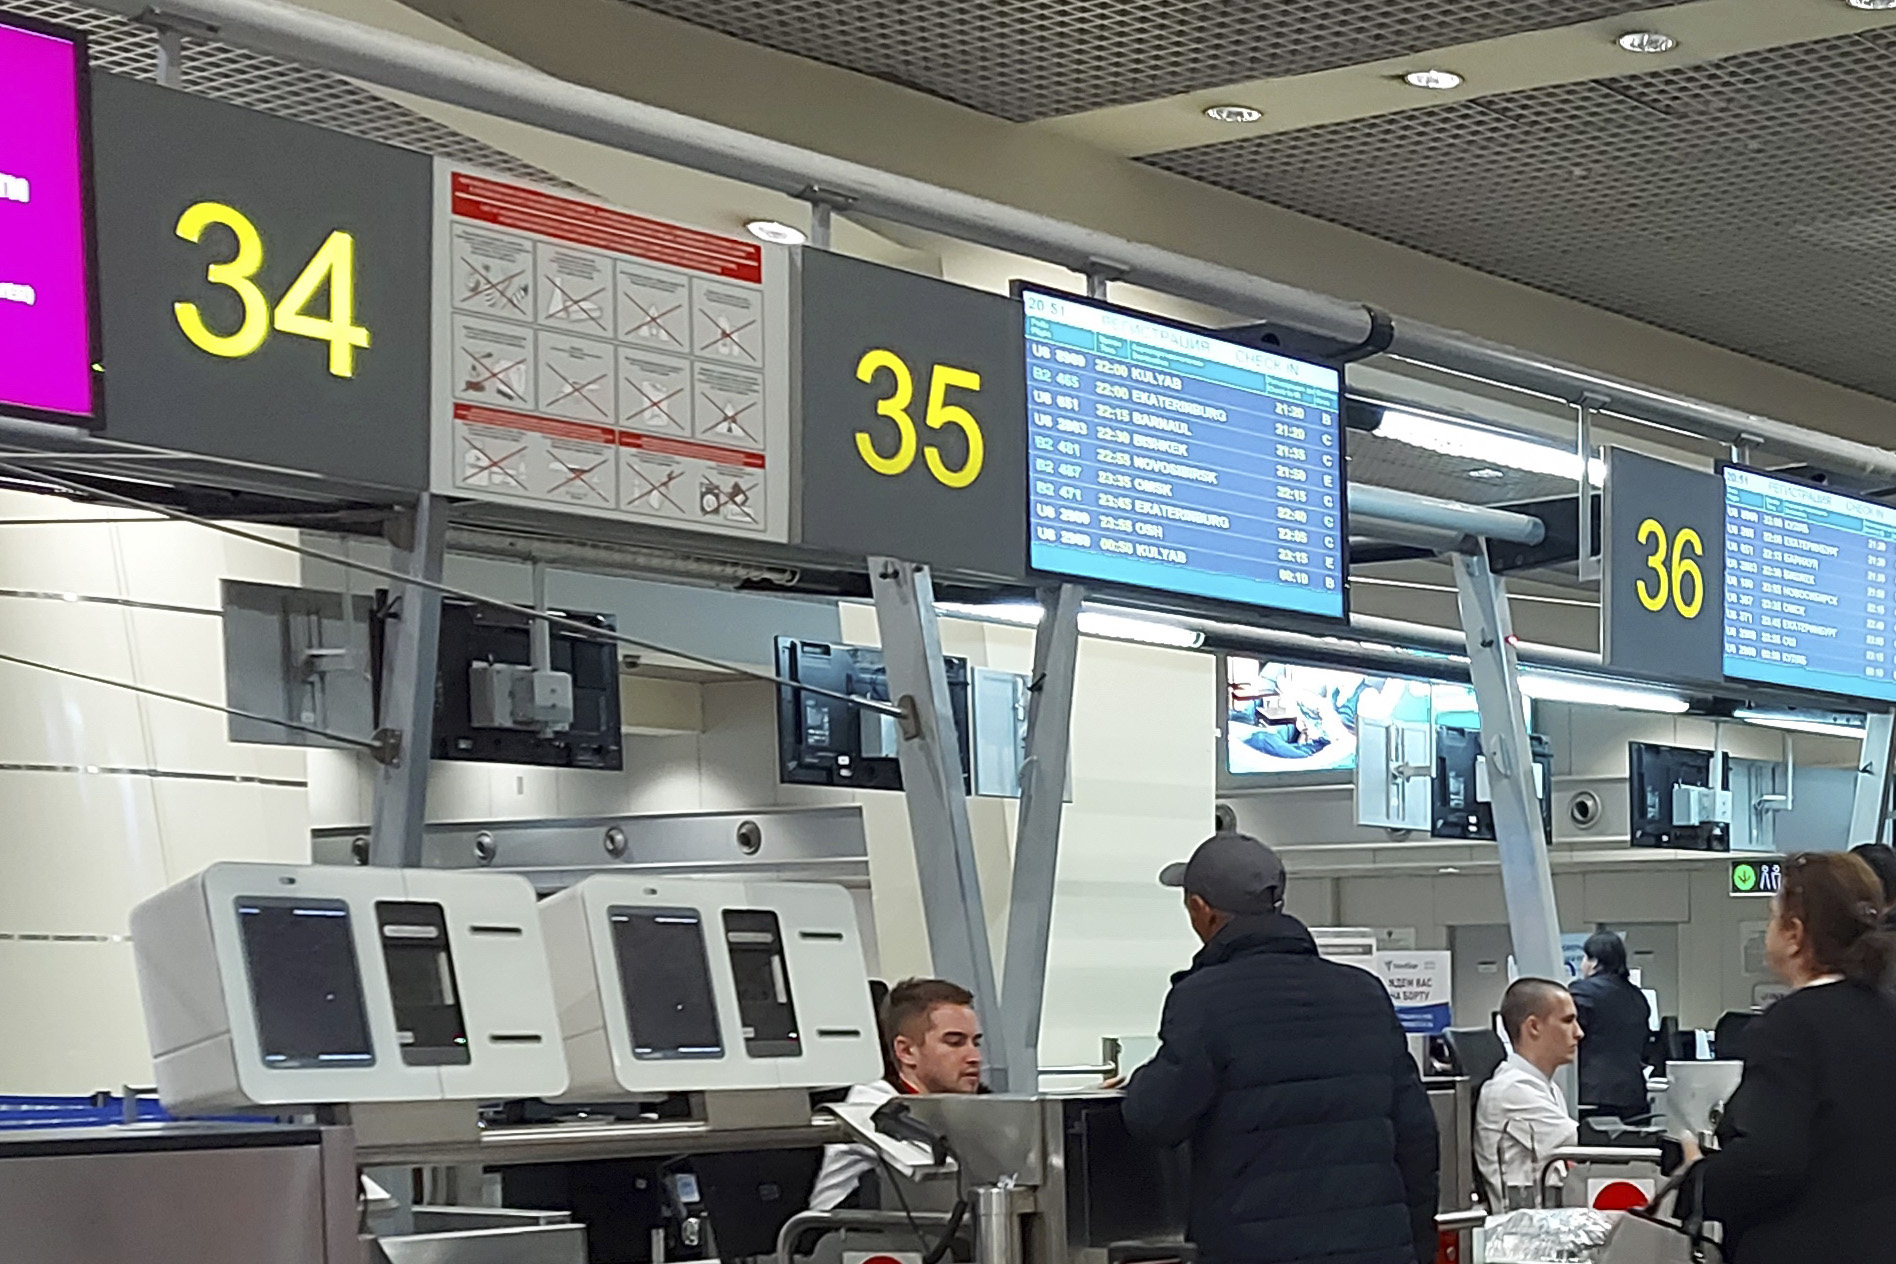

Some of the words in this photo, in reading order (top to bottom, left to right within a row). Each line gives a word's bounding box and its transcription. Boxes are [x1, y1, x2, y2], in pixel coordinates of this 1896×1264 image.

[173, 202, 370, 378] 34
[1131, 366, 1182, 390] KULYAB
[855, 349, 984, 488] 35
[1131, 389, 1227, 422] EKATERINBURG
[1134, 499, 1230, 529] EKATERINBURG
[1135, 543, 1187, 564] KULYAB
[1636, 518, 1704, 619] 36
